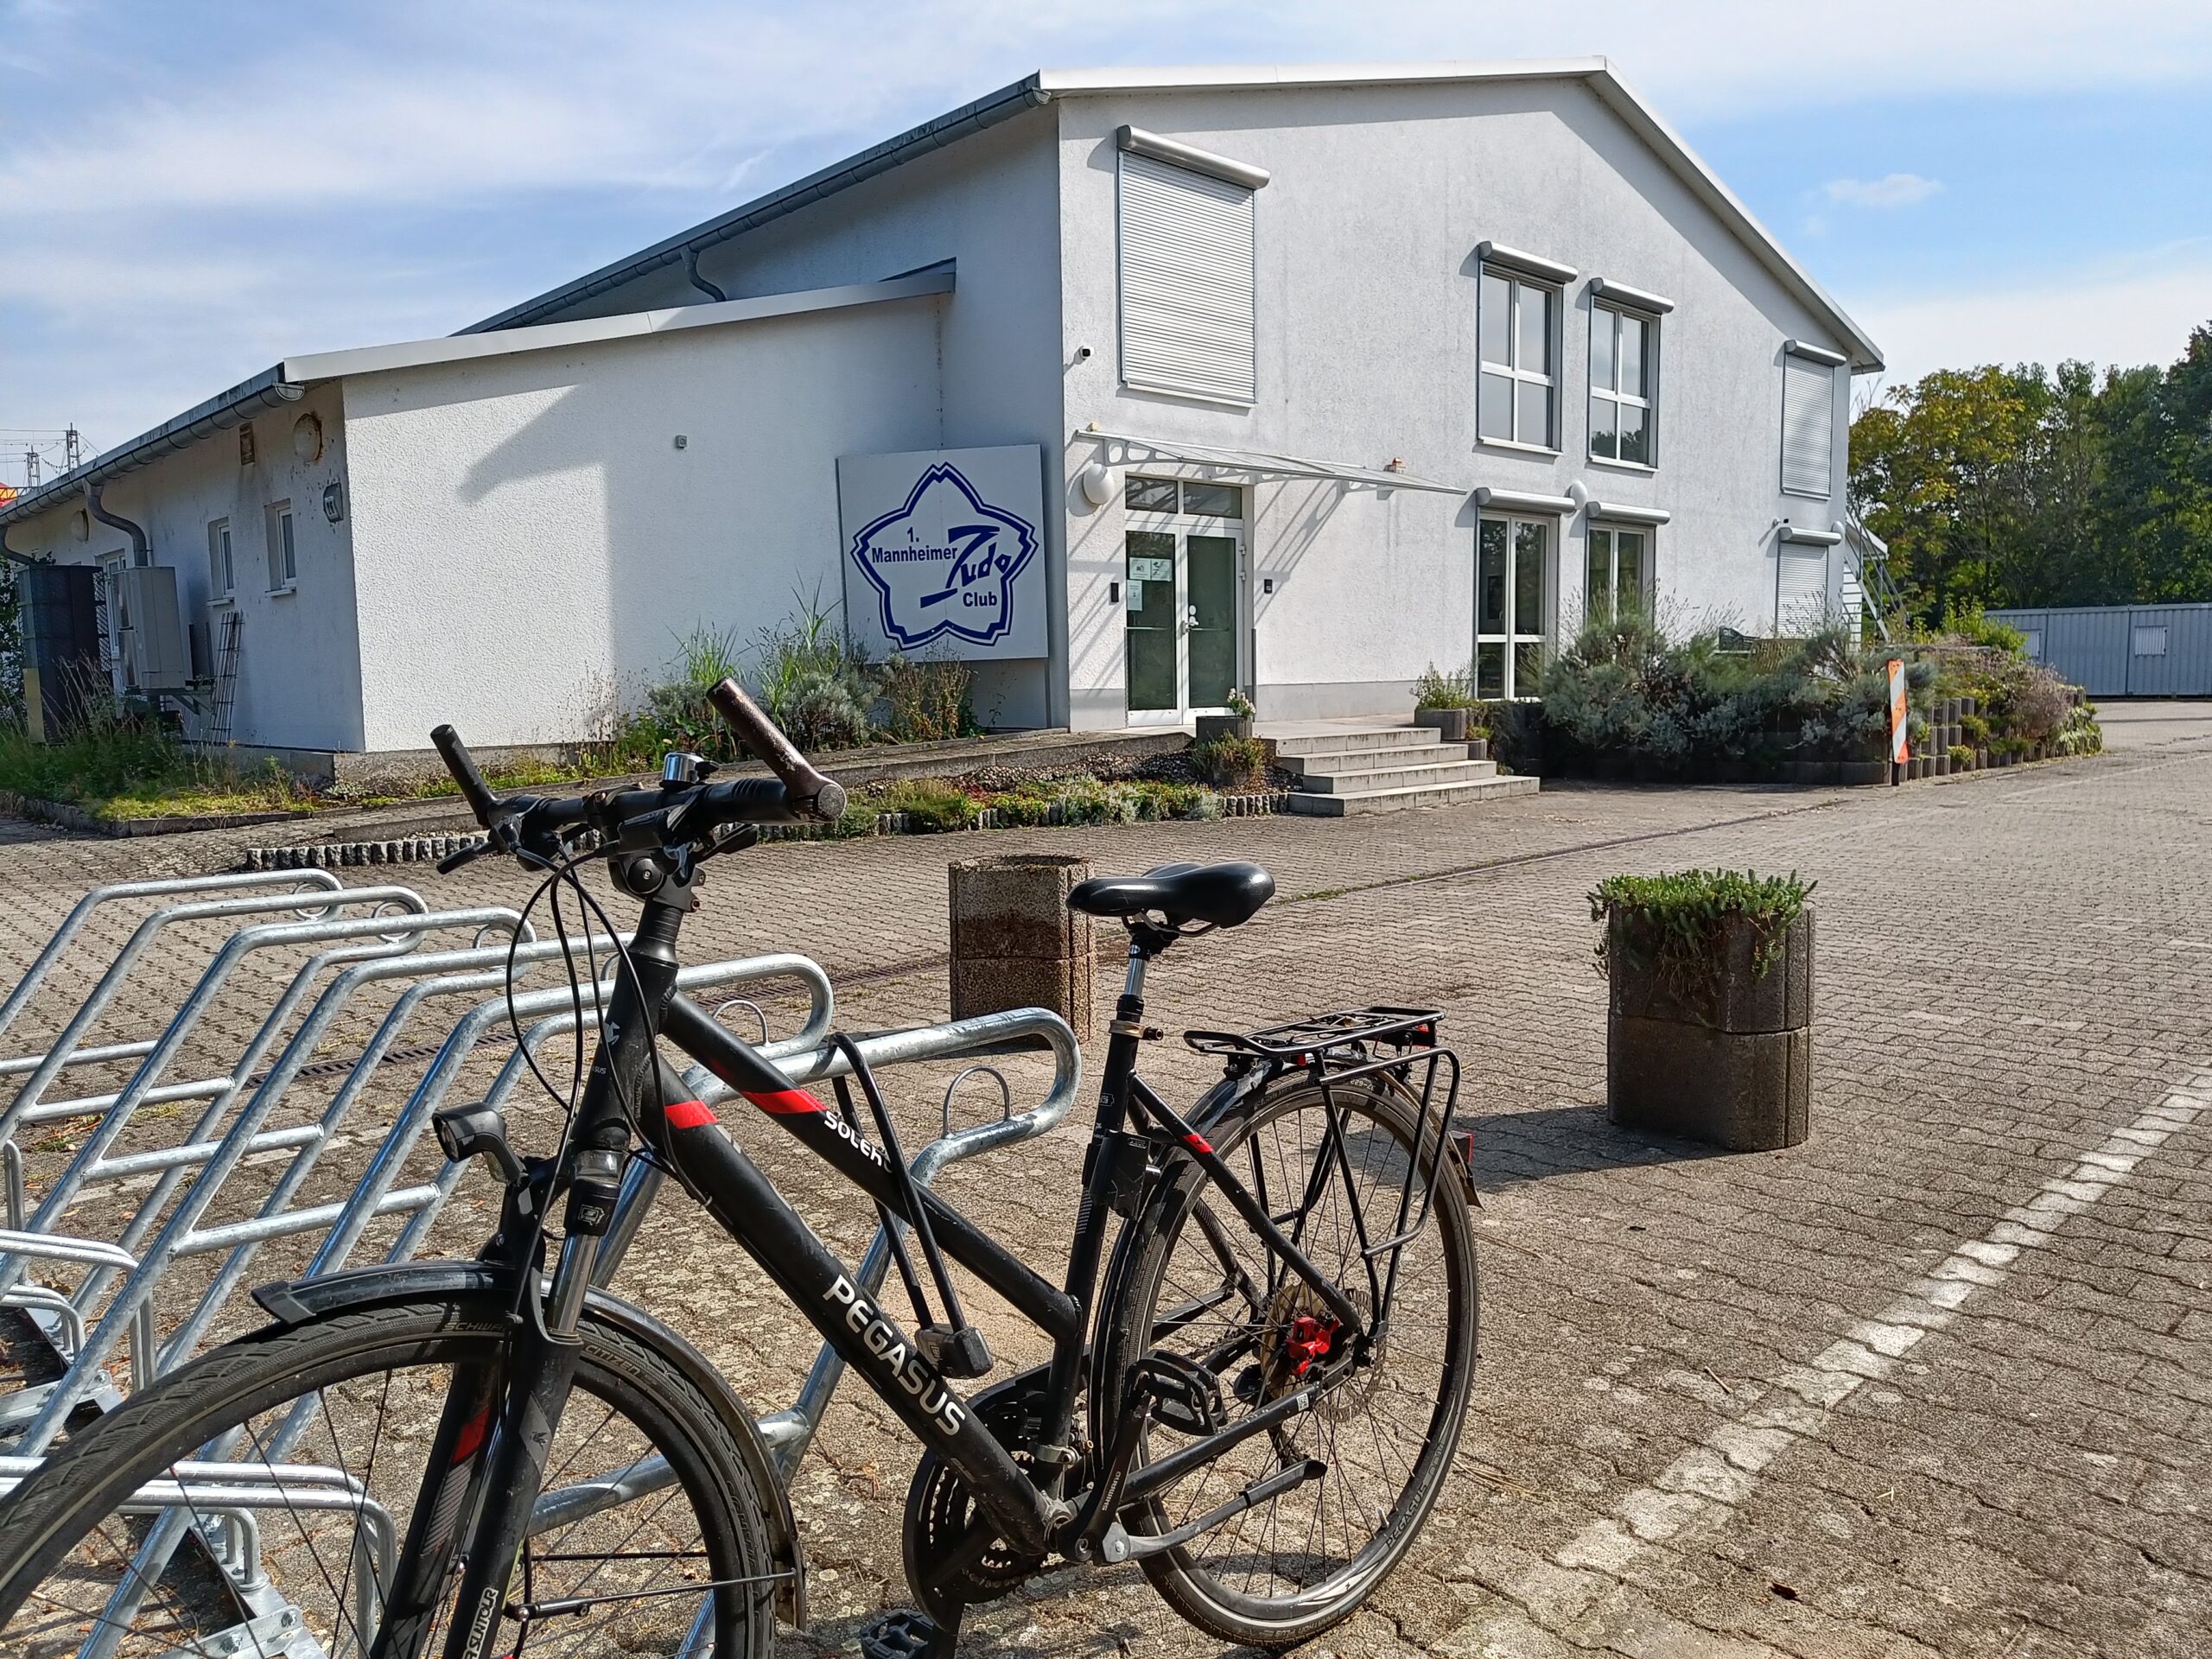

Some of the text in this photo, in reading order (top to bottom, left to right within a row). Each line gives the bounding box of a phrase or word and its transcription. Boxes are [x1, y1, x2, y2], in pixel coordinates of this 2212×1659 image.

[906, 526, 919, 543] 1.
[872, 544, 958, 563] Mannheimer
[963, 591, 997, 607] Club
[442, 1322, 506, 1332] SCHWA
[585, 1344, 641, 1376] CITIZEN
[822, 1273, 967, 1436] PEGASUS
[1102, 1471, 1122, 1511] SHIMANO
[1385, 1484, 1427, 1548] PEGASUS
[468, 1589, 497, 1651] SUNTOUR
